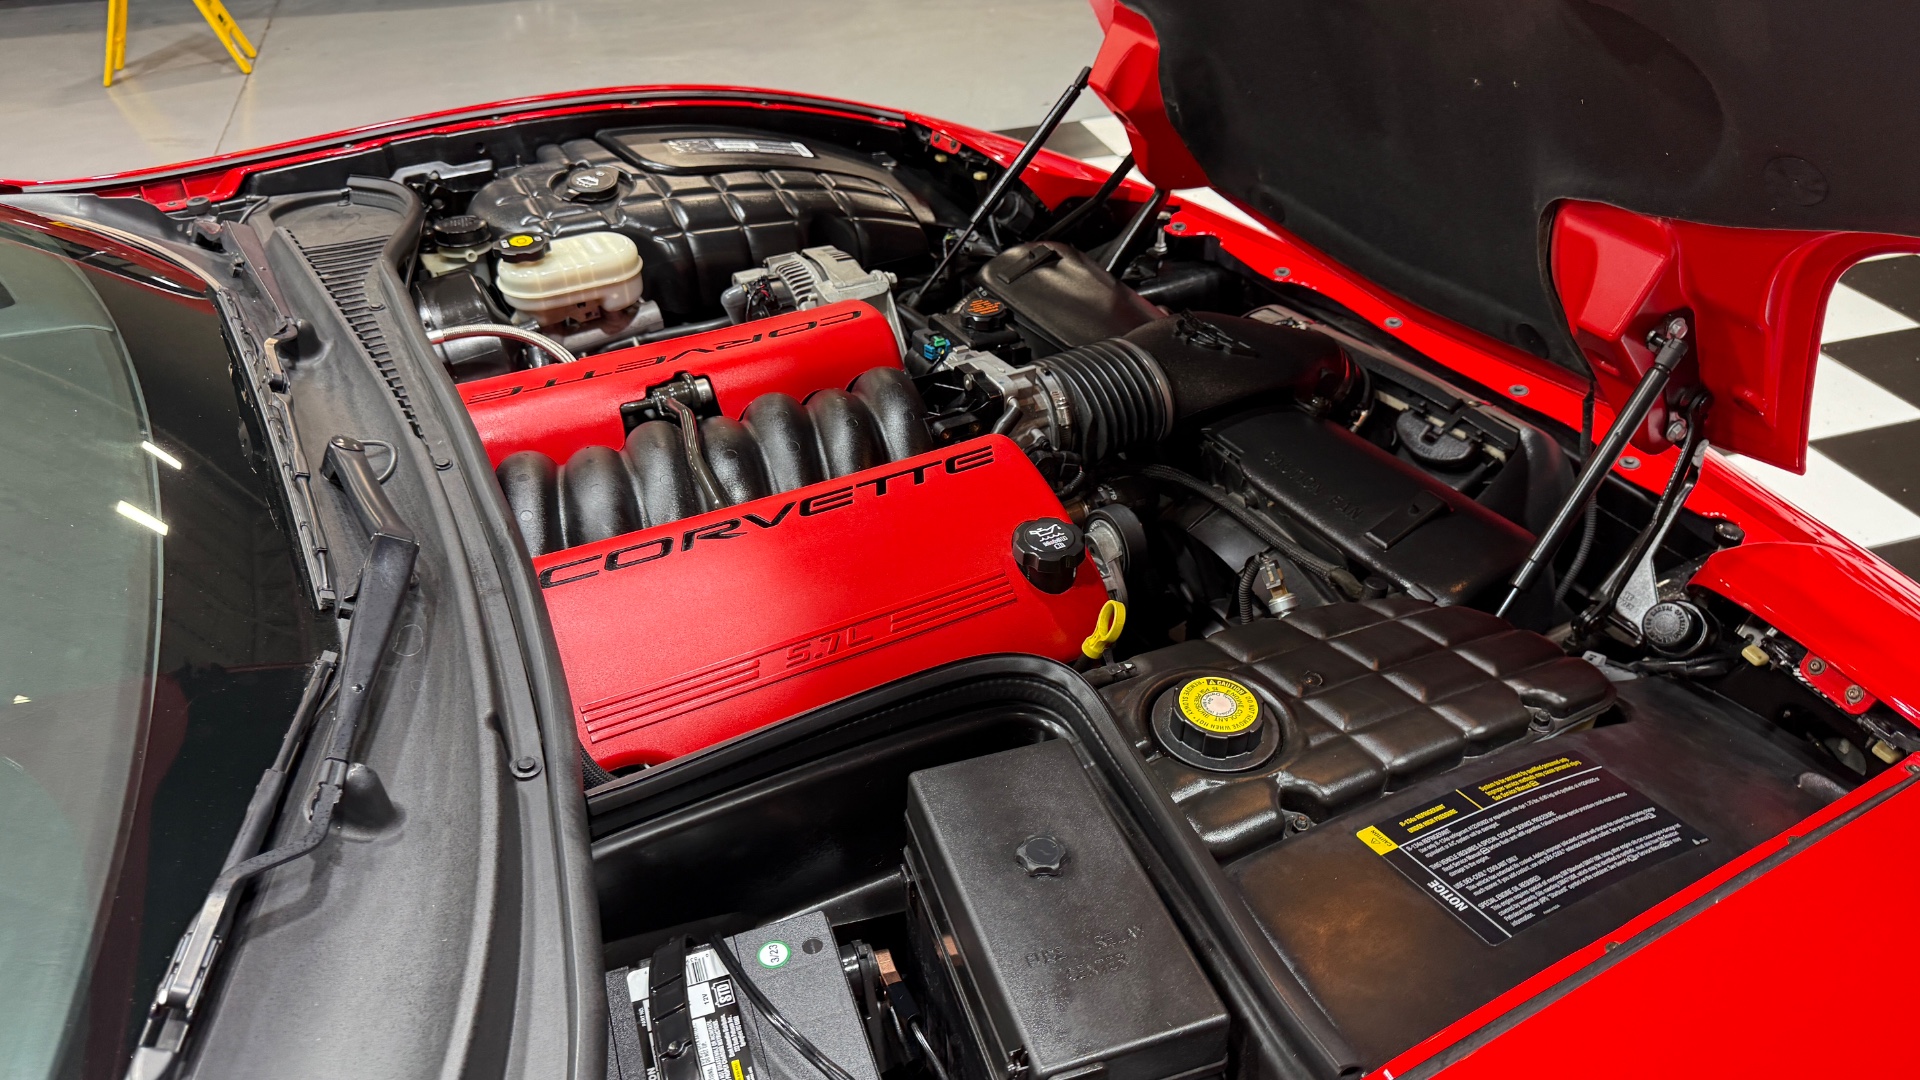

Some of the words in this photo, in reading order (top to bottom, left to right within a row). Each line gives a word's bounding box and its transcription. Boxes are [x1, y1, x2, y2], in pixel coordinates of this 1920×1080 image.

[467, 310, 861, 404] CORVETTE
[538, 444, 994, 588] CORVETTE
[786, 625, 874, 669] 5.7L
[1217, 681, 1246, 695] CAUTION
[1196, 718, 1209, 727] HOT
[1214, 709, 1243, 722] COOLANT
[1233, 714, 1253, 729] REMOVE
[1370, 830, 1393, 846] CAUTION
[1426, 880, 1469, 911] NOTICE
[769, 944, 780, 963] 3/23
